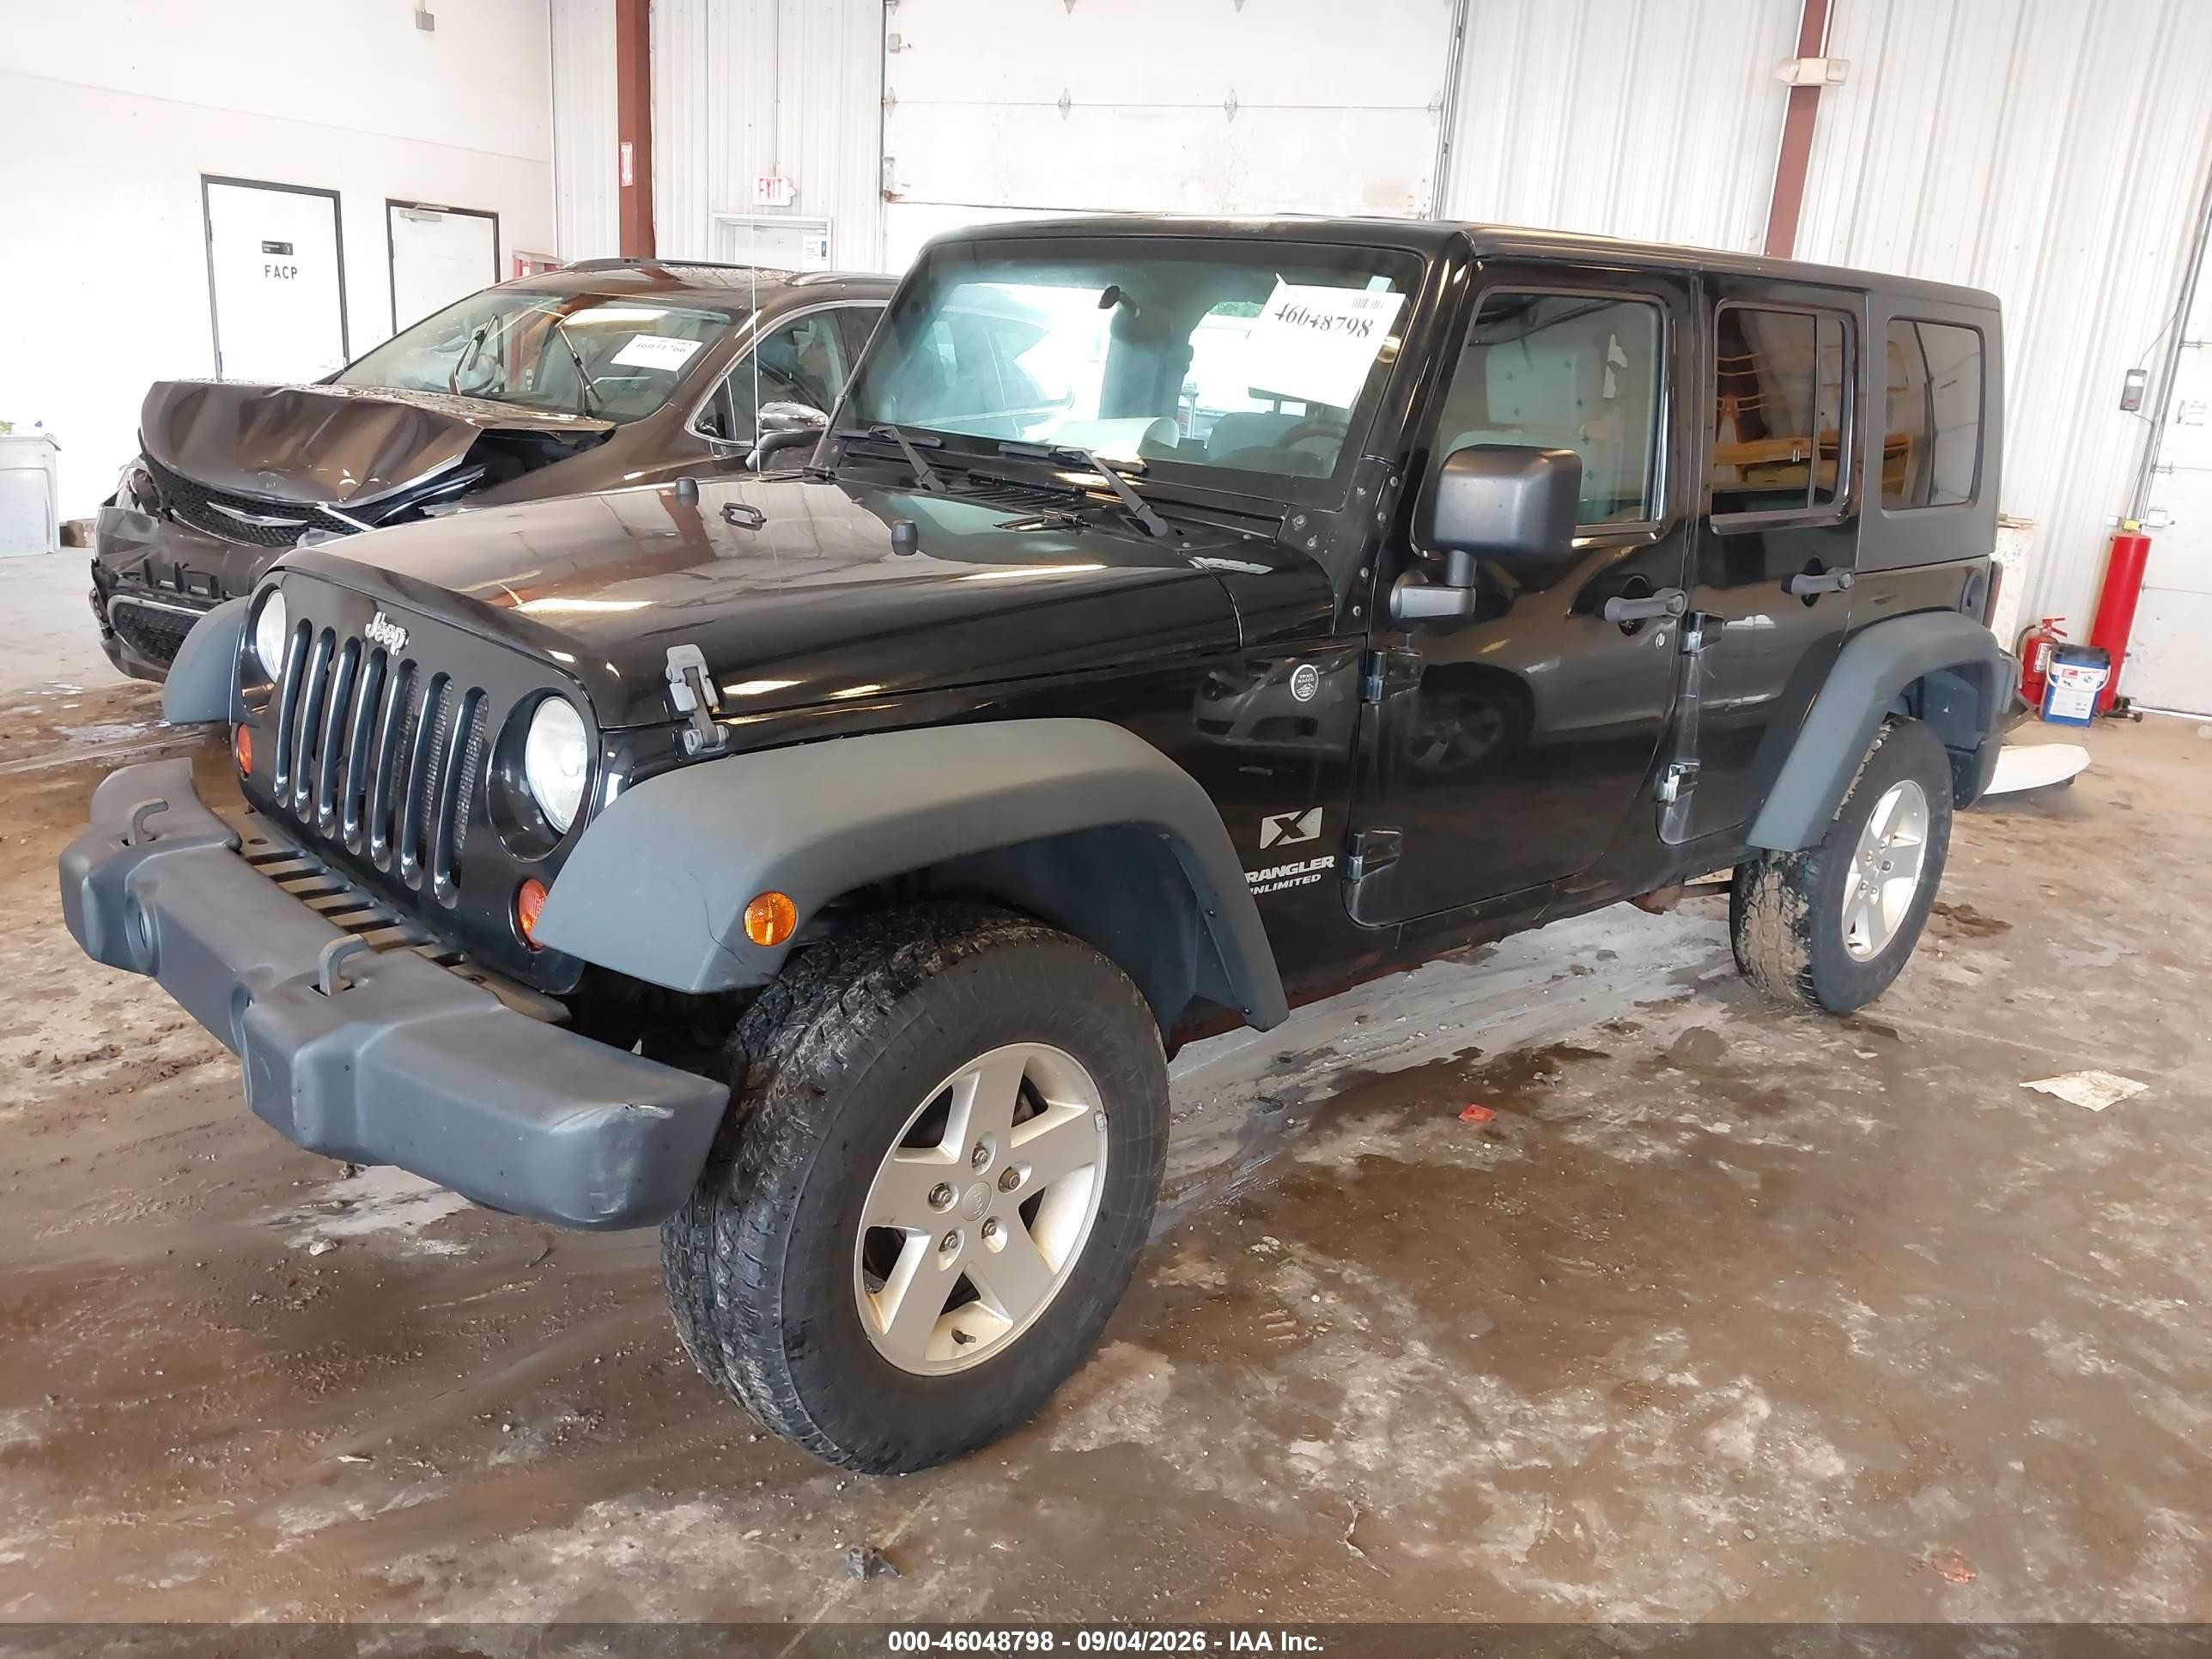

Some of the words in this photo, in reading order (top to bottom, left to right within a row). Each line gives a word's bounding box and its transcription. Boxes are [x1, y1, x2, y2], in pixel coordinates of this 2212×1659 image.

[758, 178, 782, 200] EXIT
[264, 264, 298, 279] FACP
[1274, 302, 1374, 338] 46048798
[364, 611, 407, 656] Jeep
[1244, 855, 1335, 884] RANGLER
